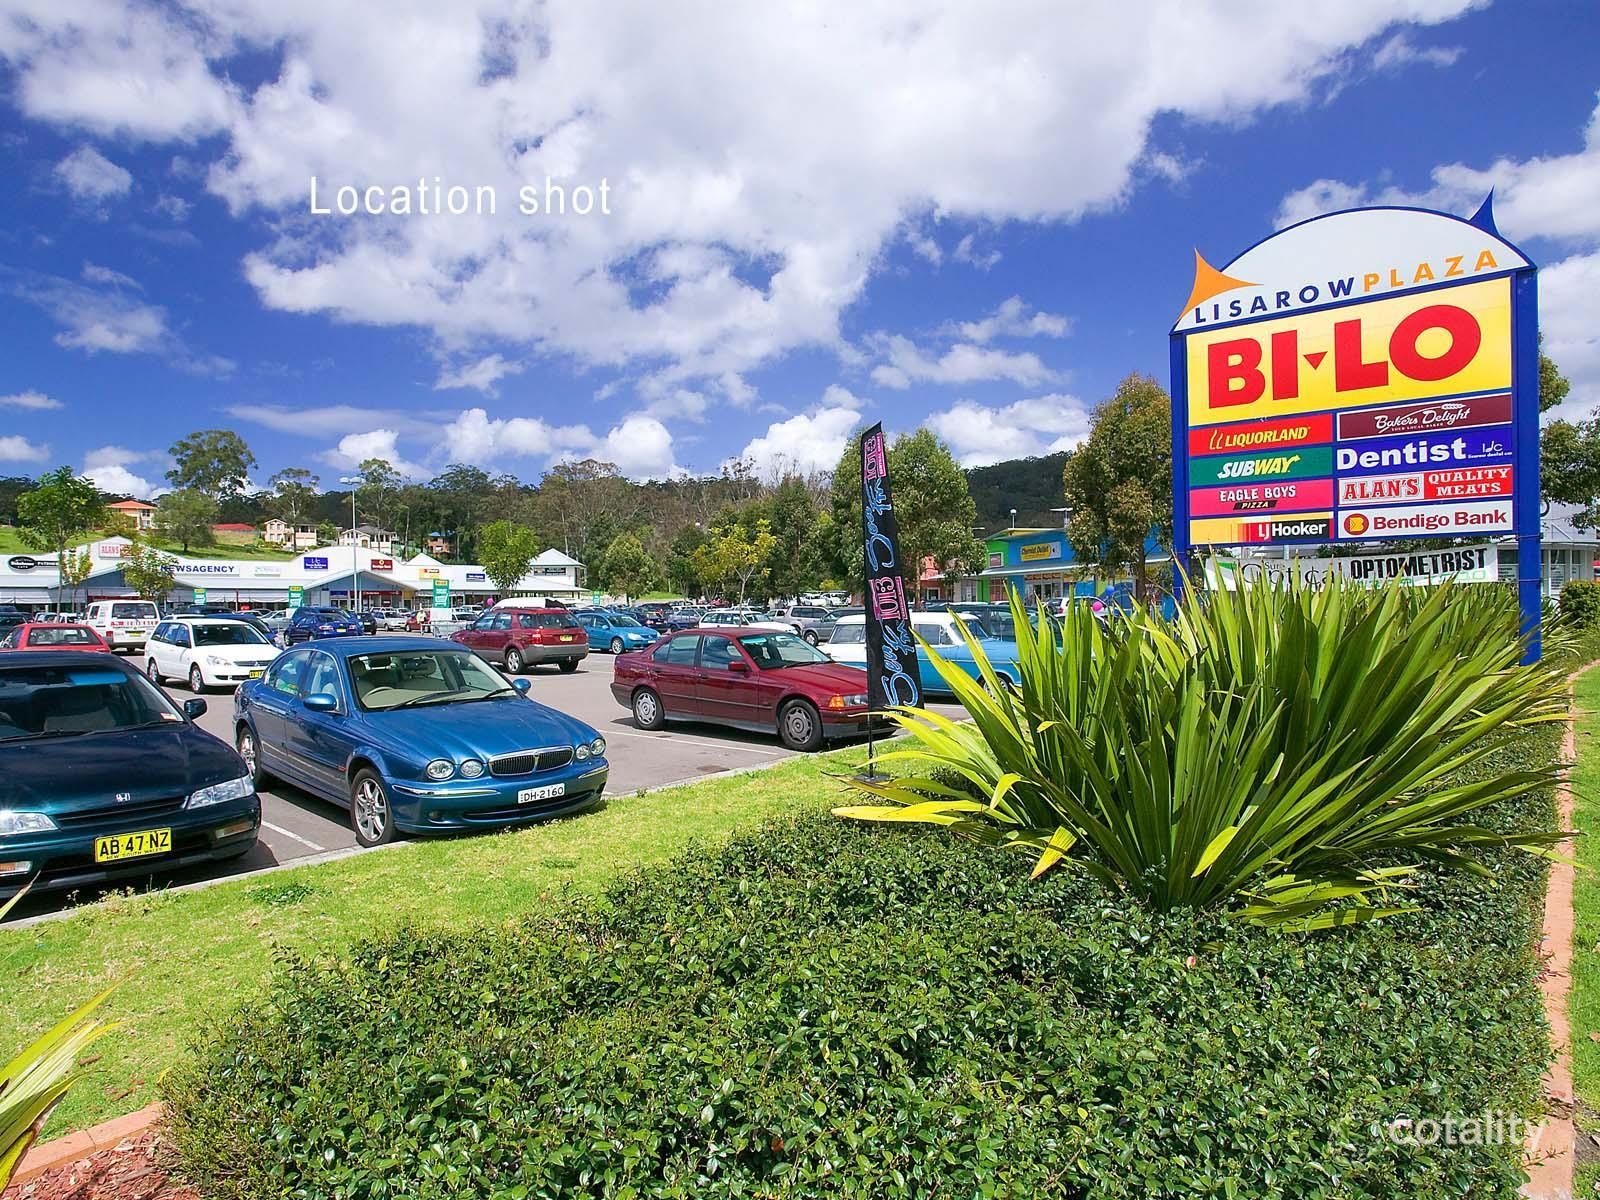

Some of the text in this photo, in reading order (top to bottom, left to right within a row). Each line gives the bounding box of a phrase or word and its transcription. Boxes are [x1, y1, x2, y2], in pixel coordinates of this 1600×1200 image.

[1375, 408, 1471, 434] Bakers Delight
[1225, 426, 1308, 447] LIQUORLAND
[1336, 437, 1467, 470] Dentist
[1217, 455, 1301, 479] SUBWAY
[1428, 468, 1510, 485] QUALITY
[1220, 485, 1296, 502] EAGLE BOYS
[1344, 478, 1420, 500] ALAN'S
[1436, 482, 1501, 496] MEATS
[1241, 501, 1269, 509] PIZZA
[1374, 509, 1507, 530] Bendigo Bank
[1350, 548, 1488, 579] OPTOMETRIST
